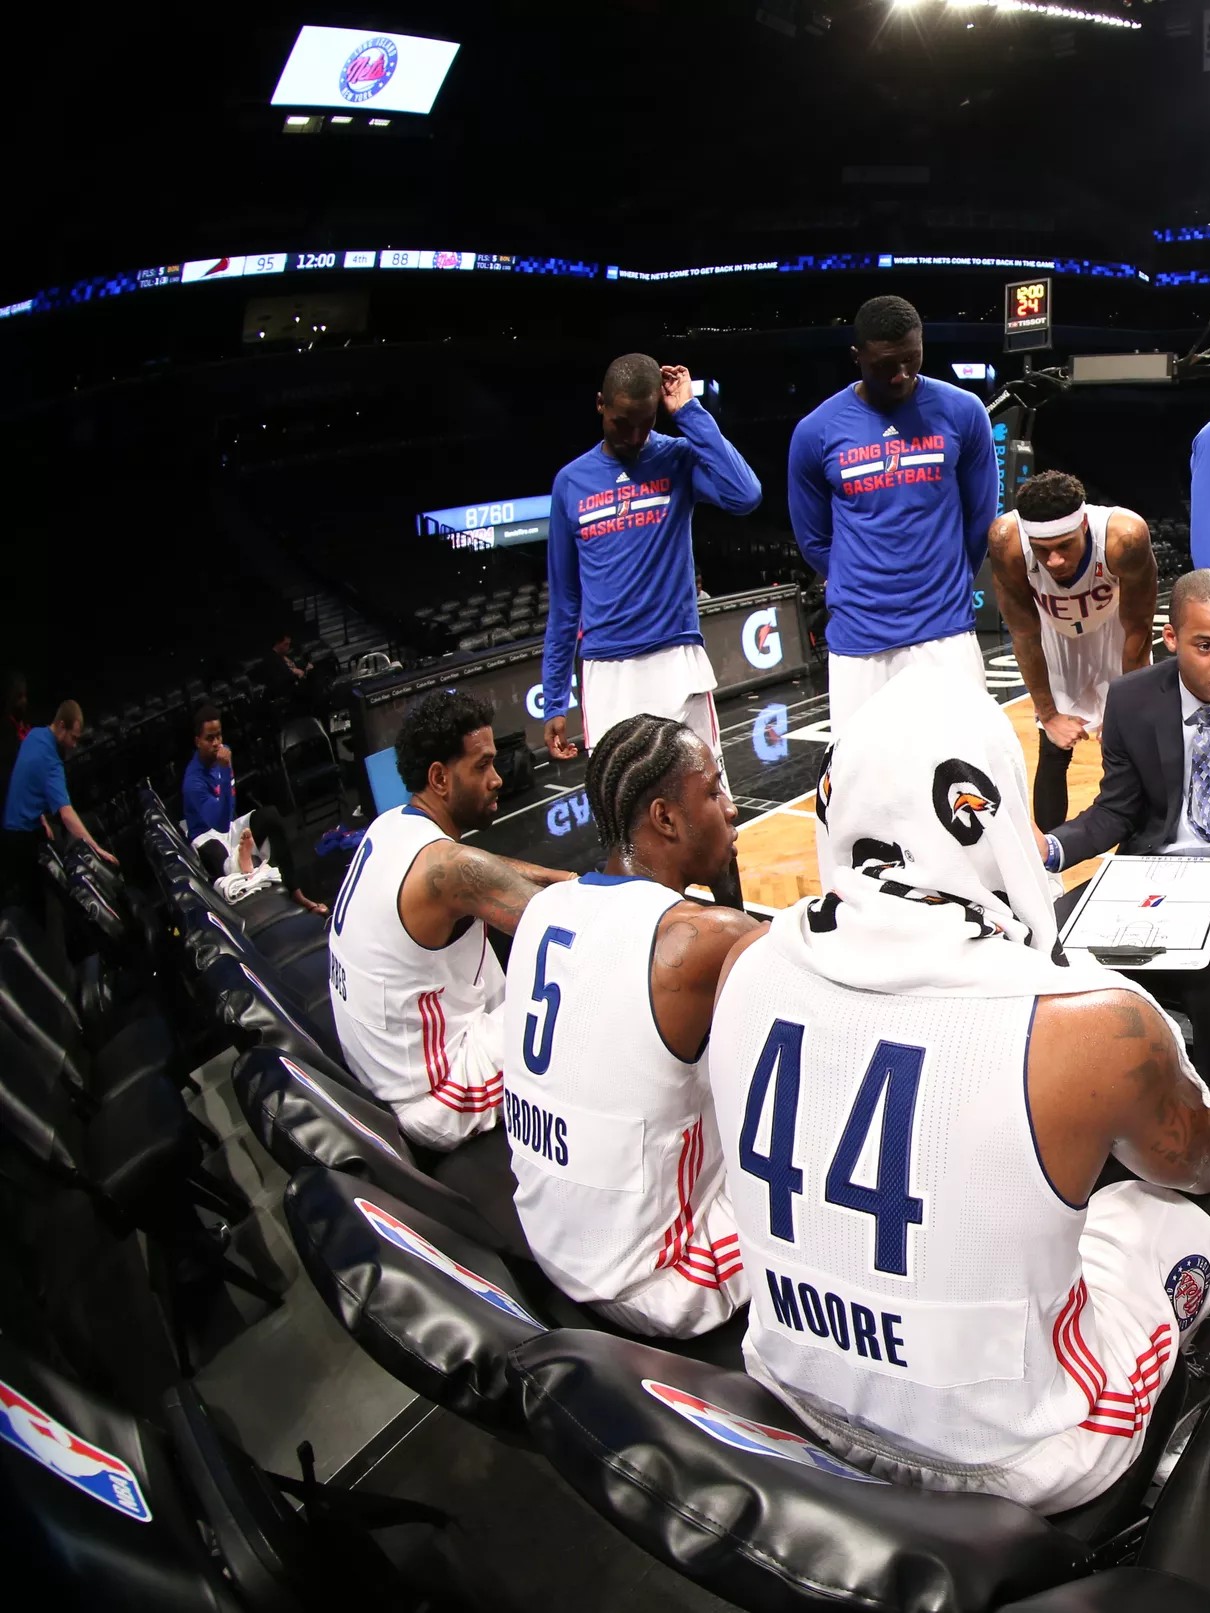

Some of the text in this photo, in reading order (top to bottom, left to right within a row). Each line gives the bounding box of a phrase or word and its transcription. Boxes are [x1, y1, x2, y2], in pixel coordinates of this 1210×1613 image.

[256, 257, 275, 272] 95
[296, 253, 337, 269] 12:00
[391, 252, 410, 267] 88
[619, 261, 779, 281] WHERE THE NETS COME TO GET BACK IN THE GAME
[893, 257, 918, 265] WHERE
[918, 257, 933, 265] THE
[933, 257, 951, 265] NETS
[951, 257, 972, 265] COME
[981, 258, 996, 266] GET
[995, 259, 1015, 267] BACK
[1014, 259, 1022, 267] IN
[1022, 260, 1036, 268] THE
[1036, 261, 1056, 269] GAME
[1018, 317, 1047, 328] TISSOT
[839, 435, 946, 467] LONG ISLAND
[578, 477, 672, 513] LONG ISLAND
[842, 466, 943, 496] BASKETBALL
[465, 502, 515, 530] 8760
[1034, 583, 1114, 621] NETS
[1070, 620, 1084, 635] 1
[522, 925, 577, 1076] 5
[505, 1087, 569, 1166] BROOKS
[738, 1017, 927, 1277] 44
[766, 1267, 909, 1368] MOORE
[108, 1473, 142, 1514] NBA
